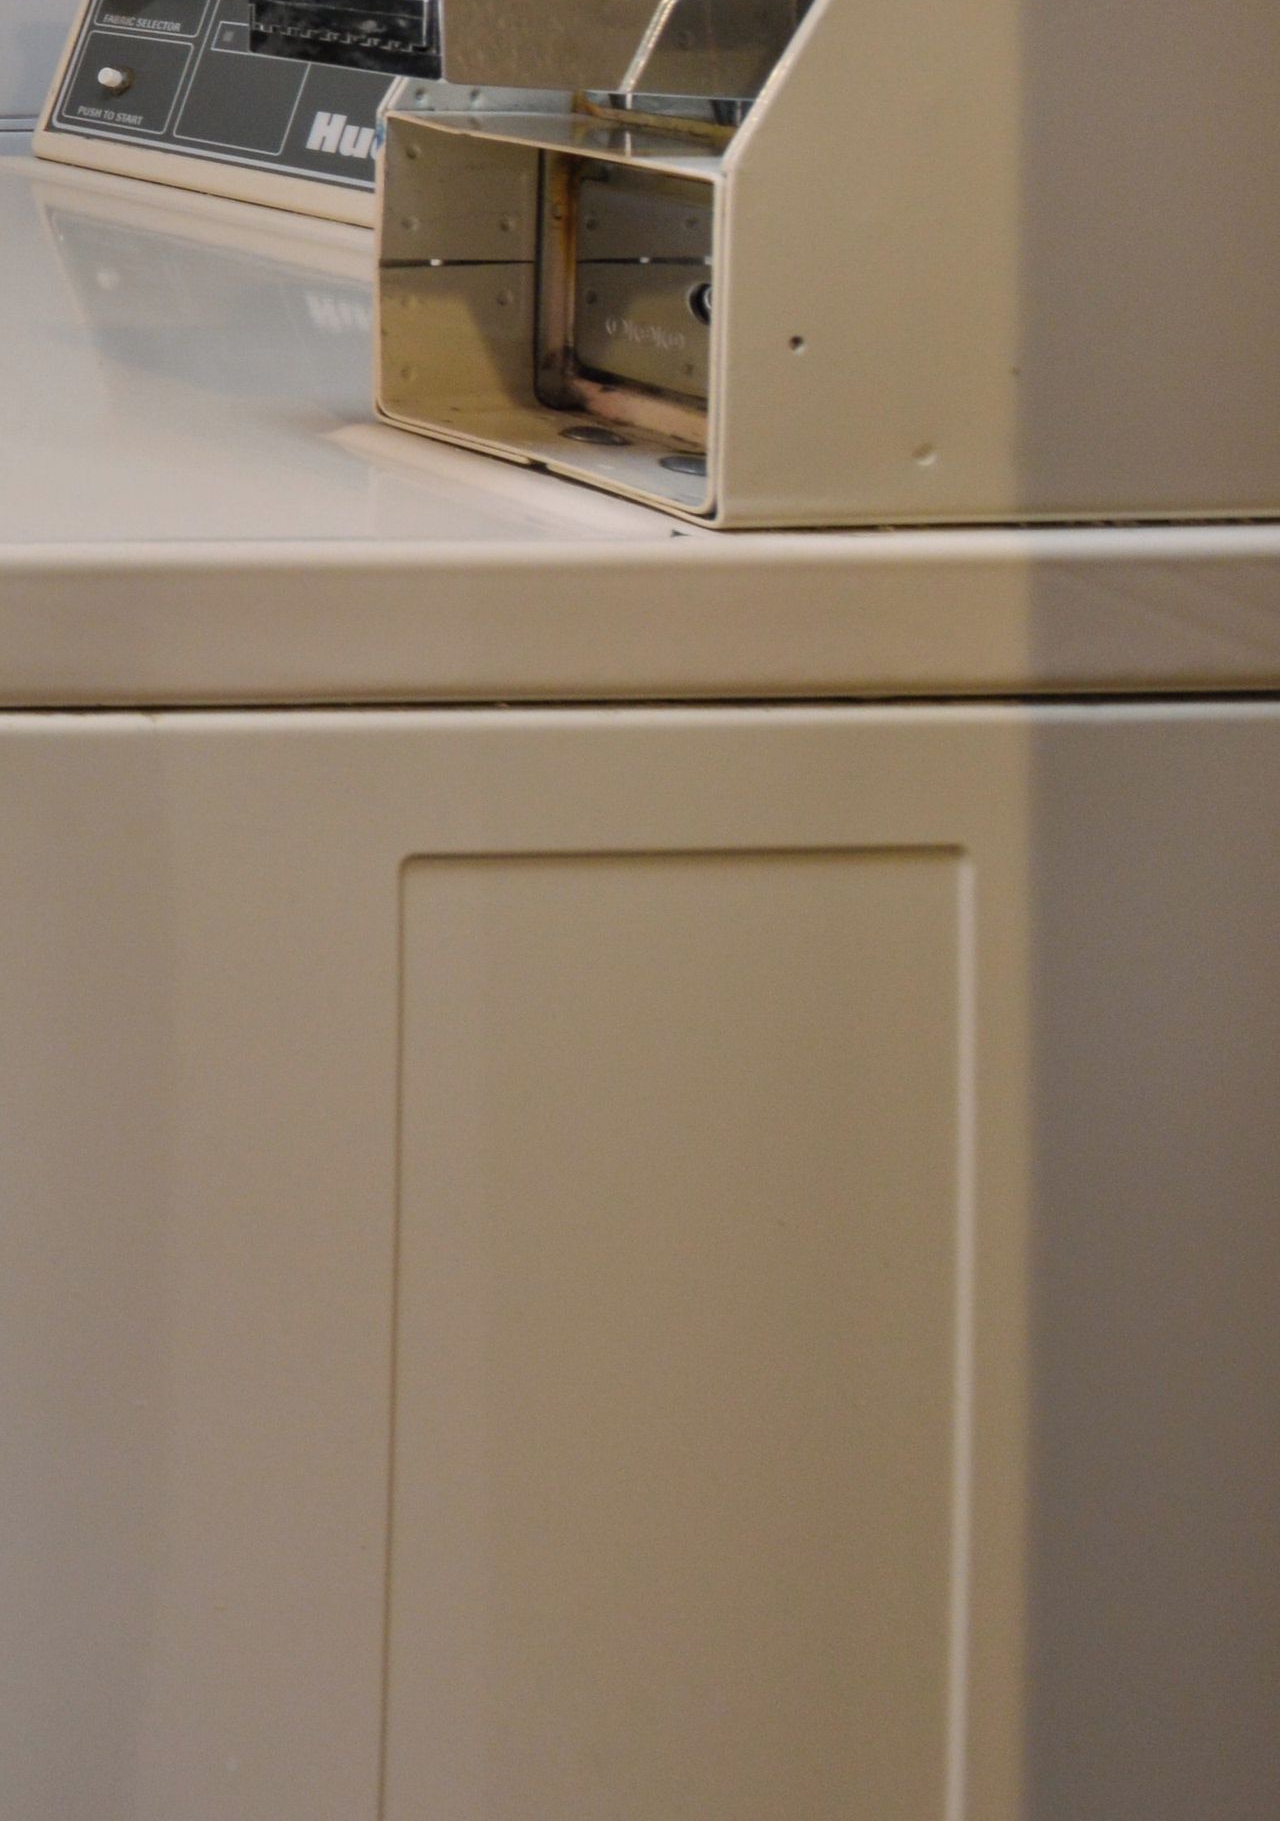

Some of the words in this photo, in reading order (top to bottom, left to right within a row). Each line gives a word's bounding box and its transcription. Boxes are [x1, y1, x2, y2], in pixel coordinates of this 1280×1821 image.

[103, 13, 136, 26] FABRIC
[136, 17, 182, 32] SELECTOR
[77, 105, 103, 118] PUSH
[104, 110, 116, 121] TO
[115, 113, 144, 126] START
[305, 111, 377, 159] Hu
